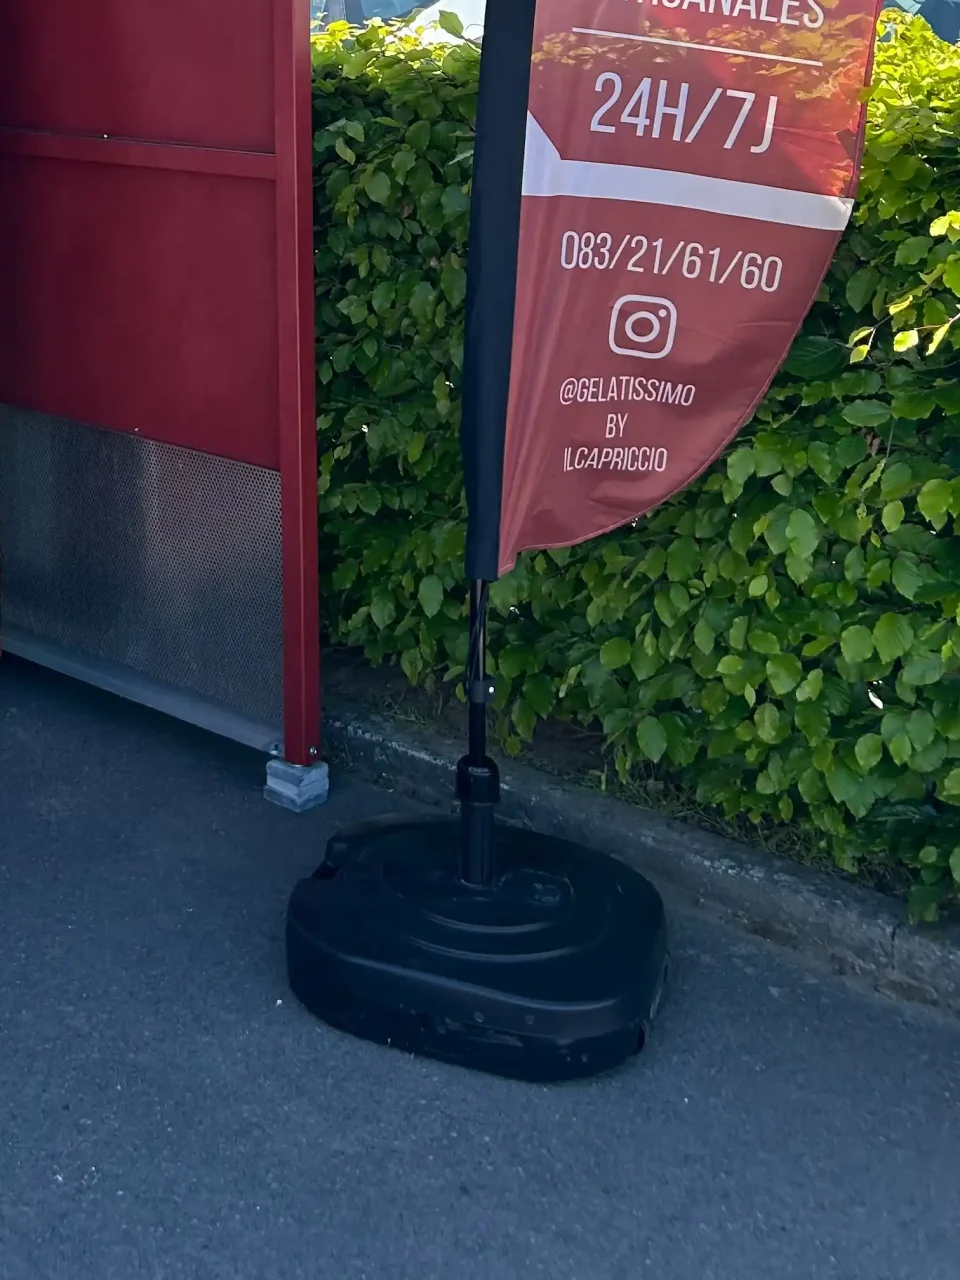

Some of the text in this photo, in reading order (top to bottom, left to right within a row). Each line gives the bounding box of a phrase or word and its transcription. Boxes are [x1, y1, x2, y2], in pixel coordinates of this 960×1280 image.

[589, 70, 778, 154] 24H/7J
[560, 230, 784, 293] 083/21/61/60
[559, 375, 697, 407] @GELATISSIMO
[605, 413, 629, 439] BY
[563, 446, 668, 472] ILCAPRICCIO
